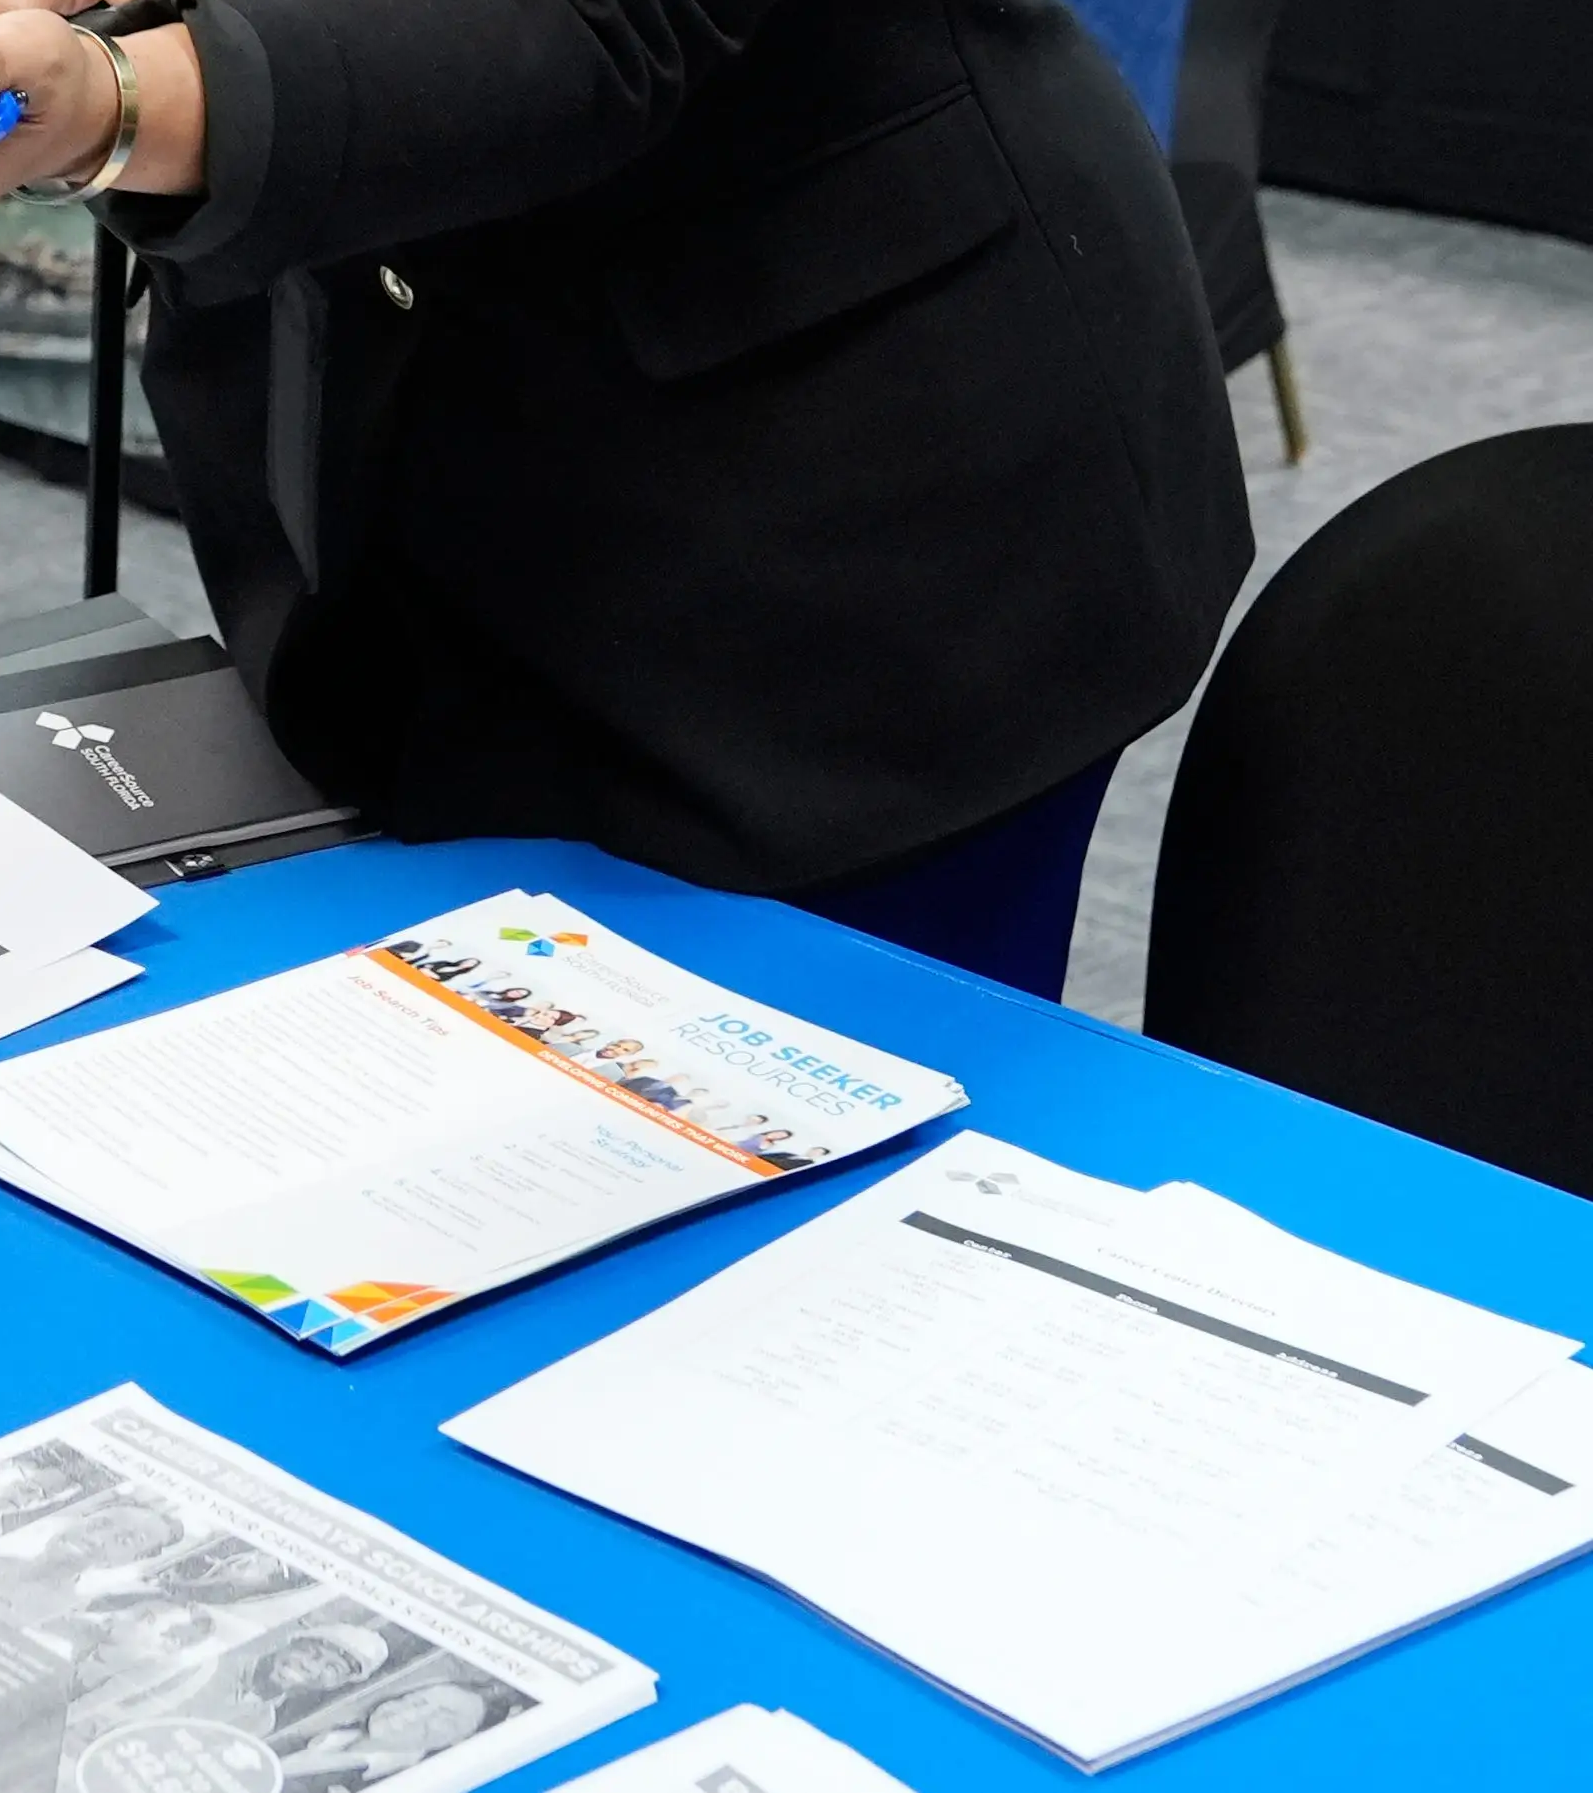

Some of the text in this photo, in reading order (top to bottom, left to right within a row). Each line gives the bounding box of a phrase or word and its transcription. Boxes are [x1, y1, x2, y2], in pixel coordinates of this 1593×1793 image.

[80, 747, 141, 811] SOUTH FLORIDA
[94, 744, 155, 808] CareerSource
[373, 989, 420, 1019] Search
[419, 1016, 450, 1037] Tips
[669, 1022, 857, 1117] RESOURCES
[699, 1013, 903, 1111] JOB SEEKER
[604, 1086, 684, 1132] COMMUNITIES
[361, 1548, 601, 1680] SCHOLARSHIPS
